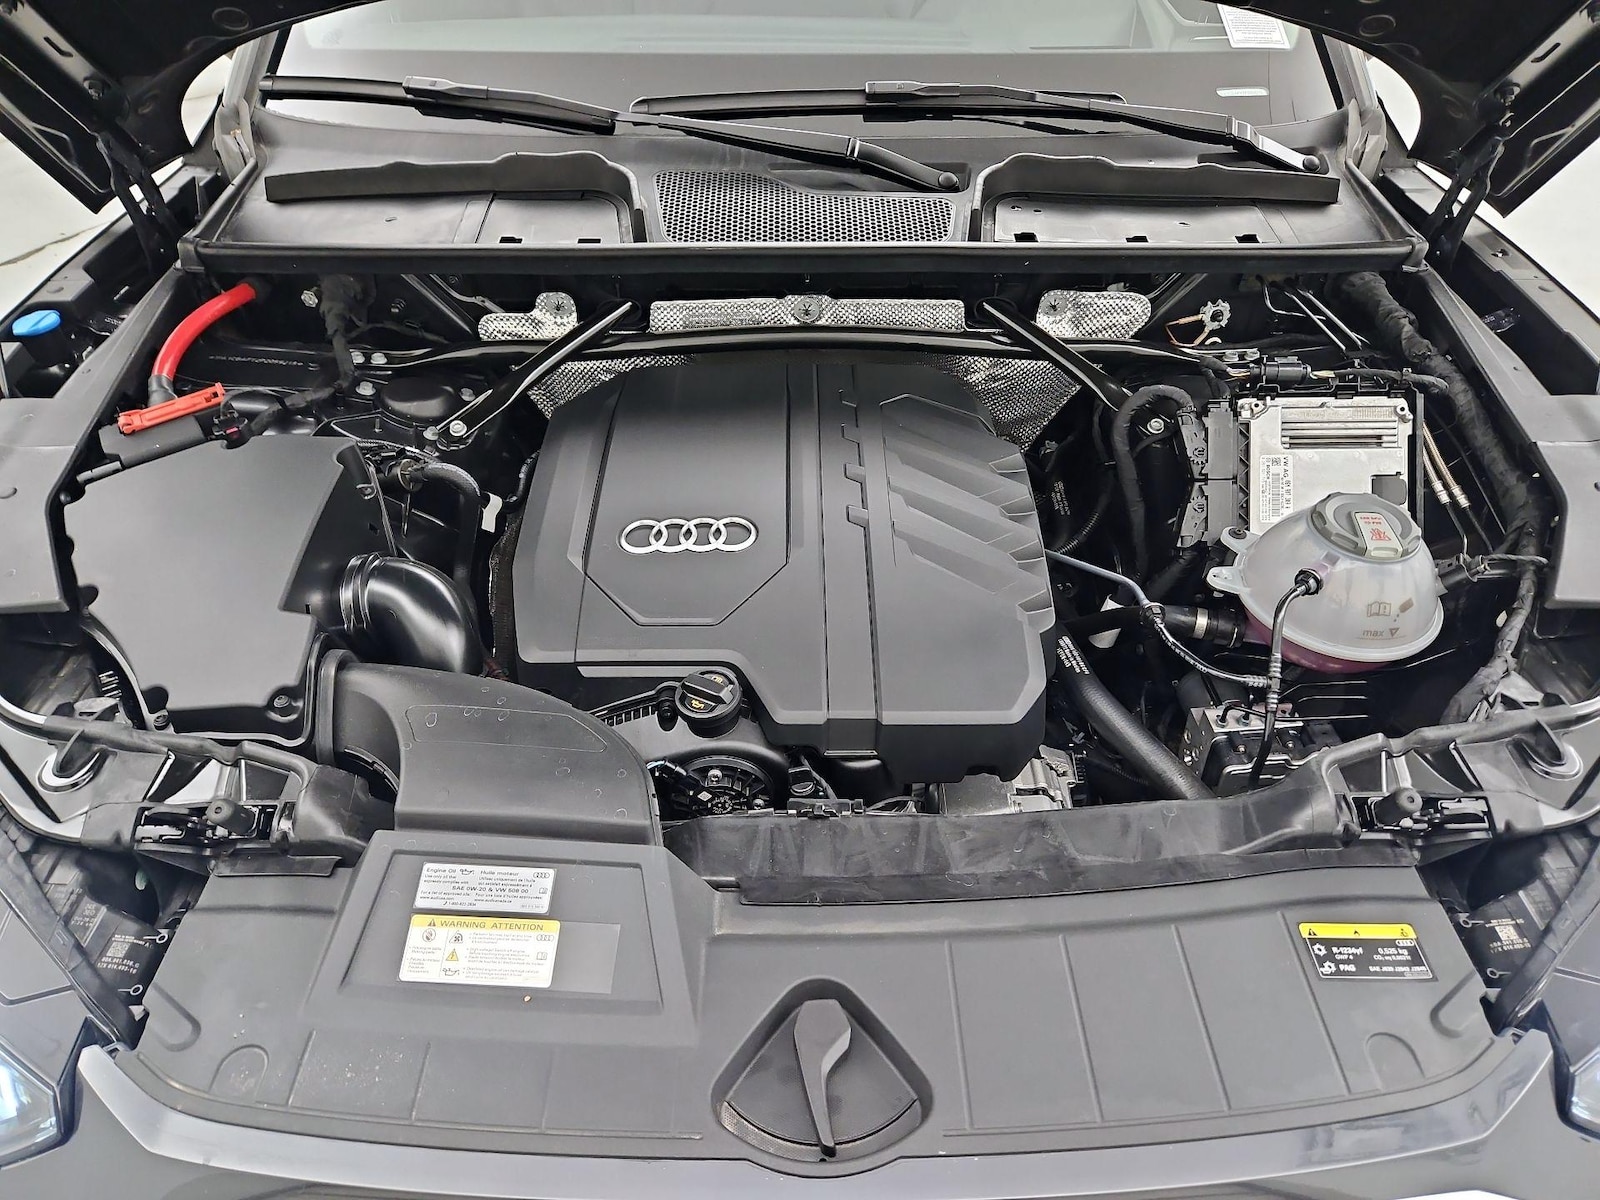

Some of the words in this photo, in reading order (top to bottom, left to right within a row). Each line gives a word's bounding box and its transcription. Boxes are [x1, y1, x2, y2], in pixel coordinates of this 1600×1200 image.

[440, 920, 486, 929] WARNING
[490, 922, 544, 931] ATTENTION
[1331, 946, 1364, 956] R-1234yf
[1377, 947, 1398, 955] 0,525
[1398, 948, 1409, 956] kg
[1338, 964, 1357, 972] PAG
